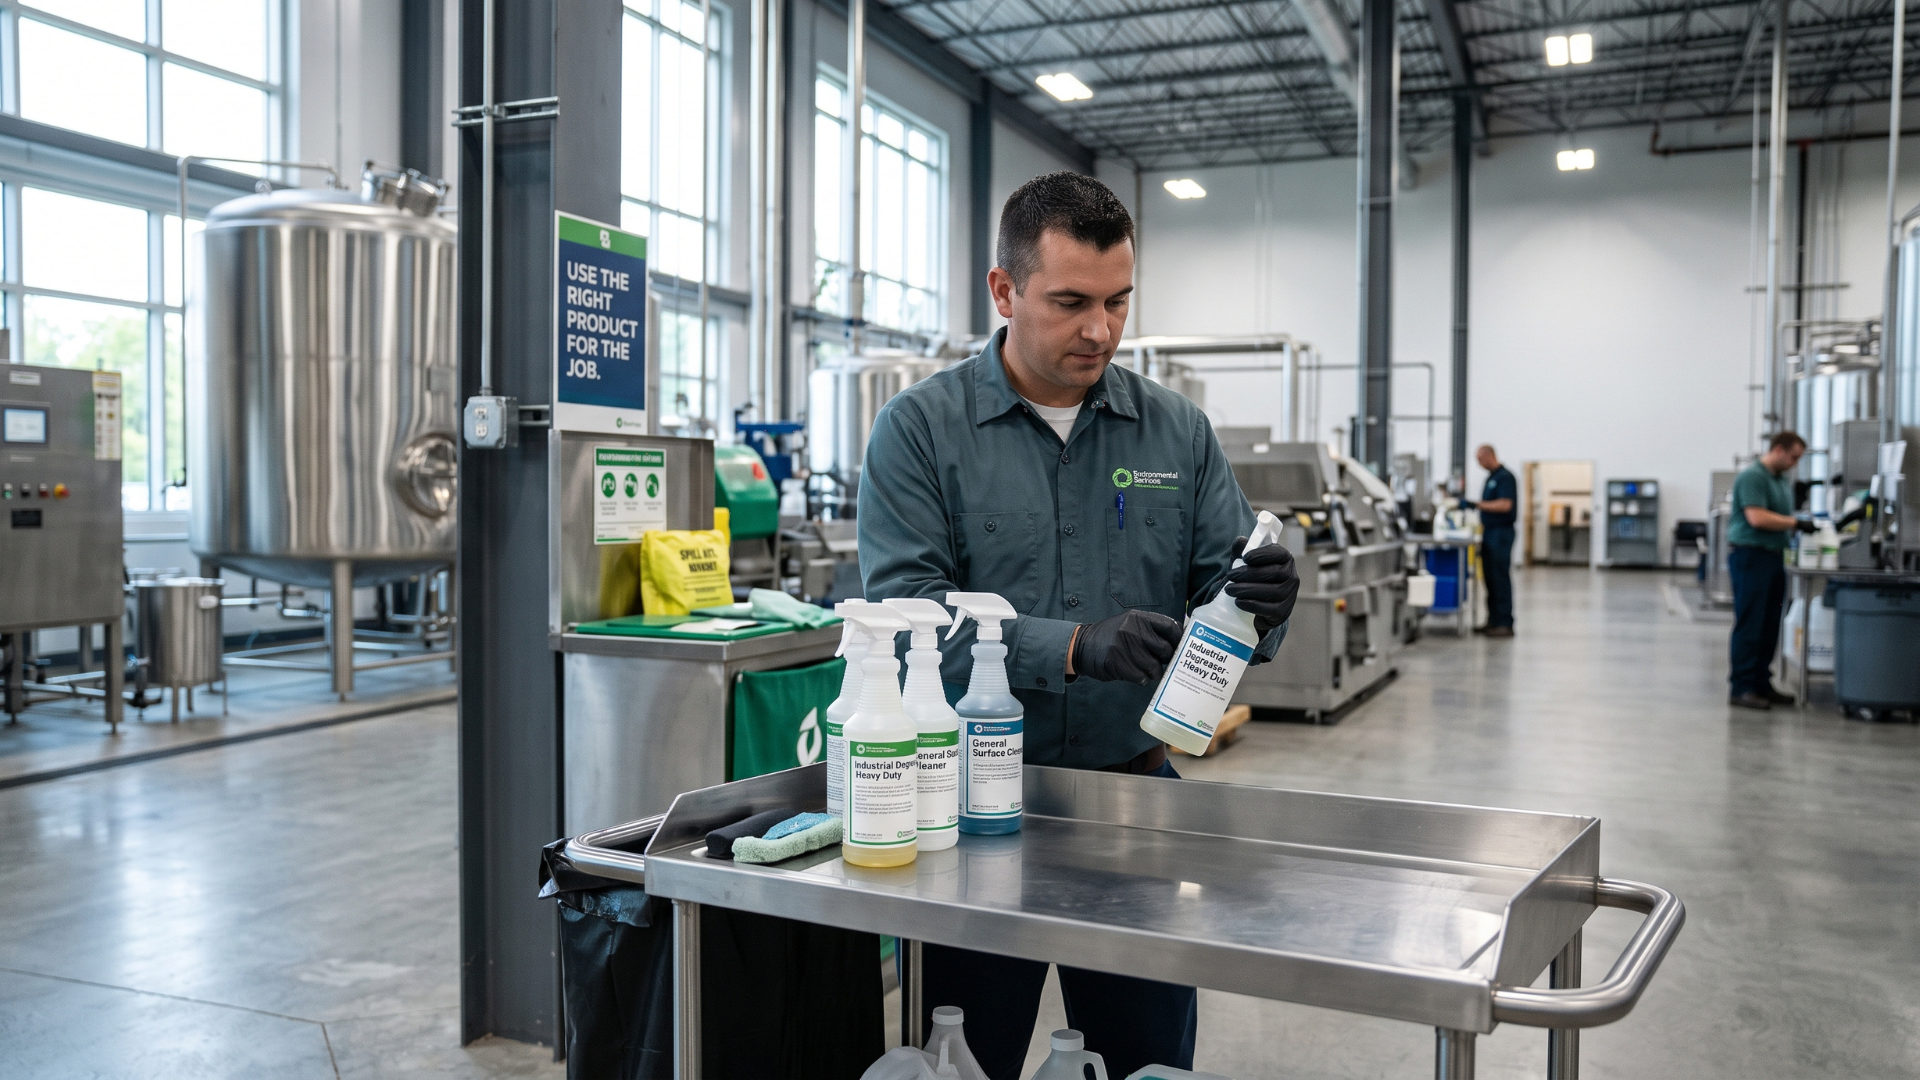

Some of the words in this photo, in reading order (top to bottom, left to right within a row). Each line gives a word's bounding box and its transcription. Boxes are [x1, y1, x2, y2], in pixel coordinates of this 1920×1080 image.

[567, 260, 598, 286] USE
[600, 268, 629, 292] THE
[567, 285, 613, 311] RIGHT
[567, 309, 638, 339] PRODUCT
[566, 333, 598, 357] FOR
[600, 338, 630, 361] THE
[566, 358, 601, 380] JOB.
[972, 738, 1007, 748] General
[916, 750, 945, 760] eneral
[972, 748, 1006, 758] Surface
[854, 760, 894, 770] Industrial
[916, 761, 947, 770] leaner
[855, 770, 881, 781] Heavy
[882, 771, 903, 781] Duty
